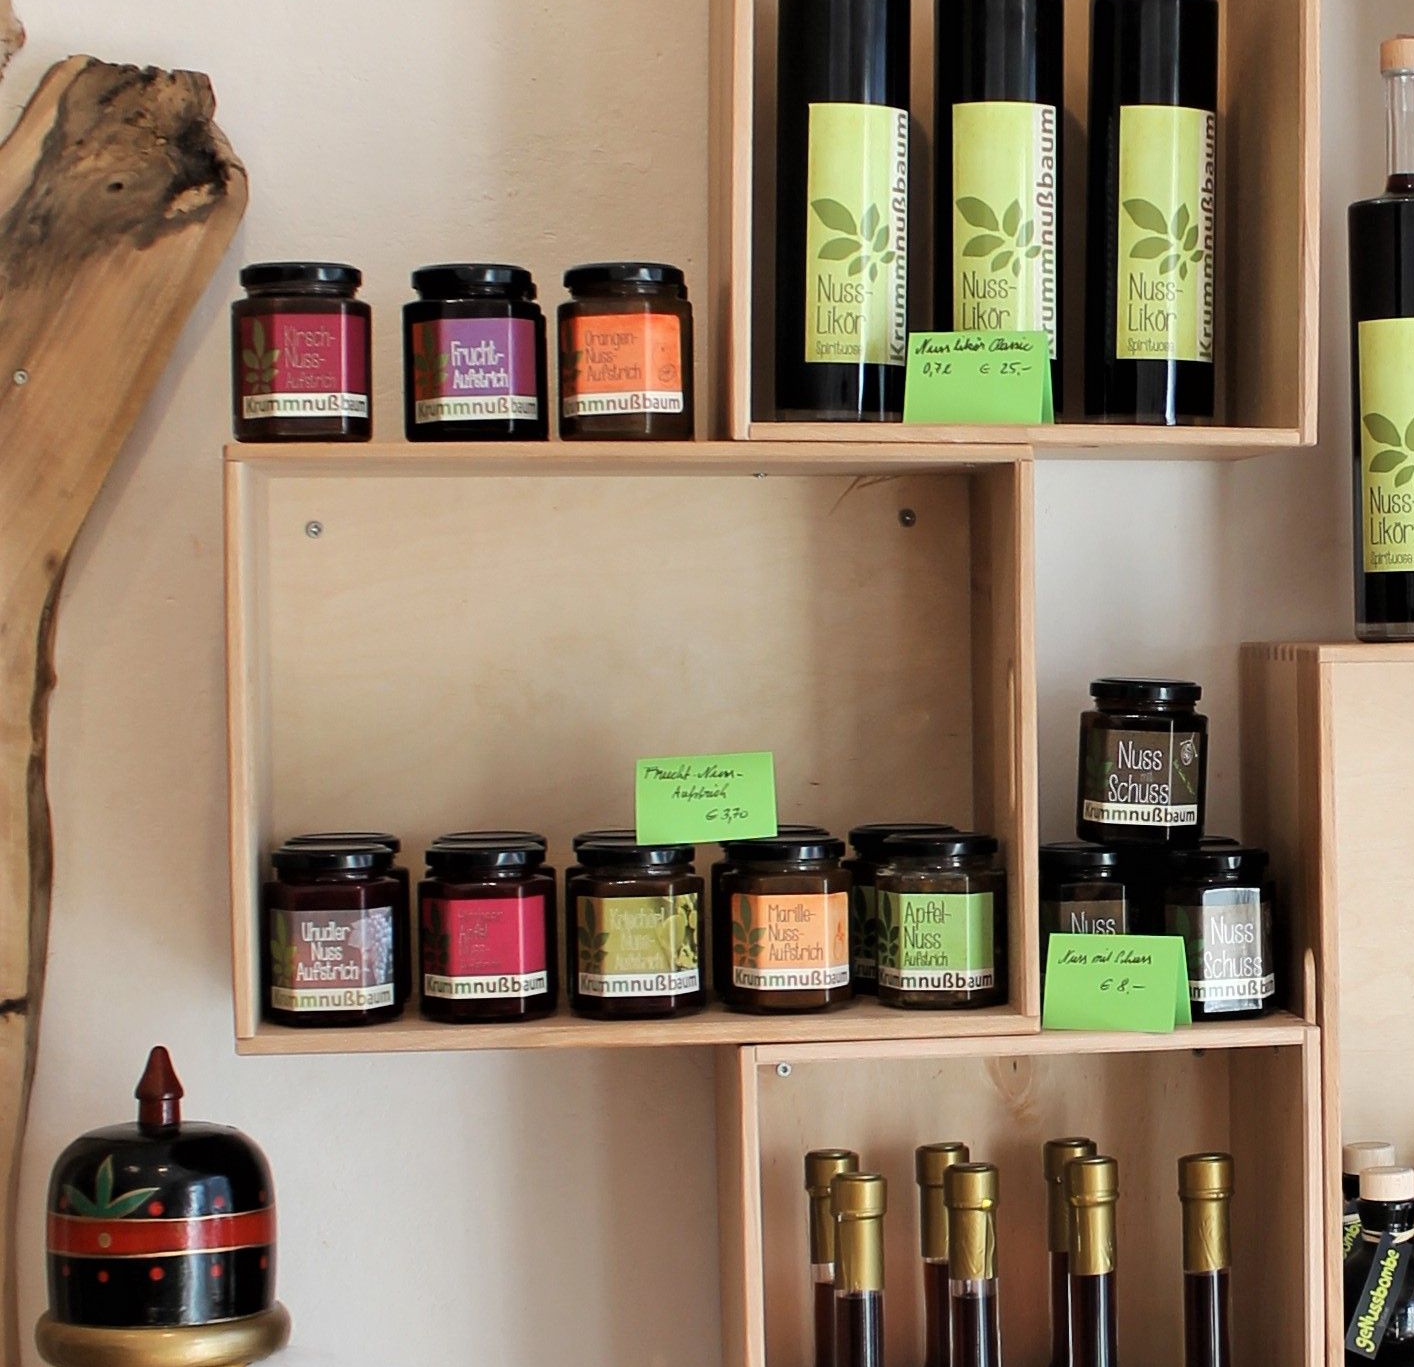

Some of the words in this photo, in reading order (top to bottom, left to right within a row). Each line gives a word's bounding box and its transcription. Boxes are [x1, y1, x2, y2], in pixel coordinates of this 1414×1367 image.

[889, 113, 907, 360] Krummnußbaum
[1200, 114, 1215, 360] Krummnußbaum
[817, 273, 873, 303] Nuss-
[962, 271, 1017, 300] Nuss-
[1129, 273, 1184, 301] Nuss-
[816, 305, 867, 335] Likör
[961, 302, 1011, 330] Likör
[1127, 303, 1177, 332] Likör
[451, 340, 504, 367] Frucht-
[453, 369, 509, 389] Aufstrich
[587, 364, 642, 382] Aufstrich
[1370, 517, 1414, 545] Likör
[1118, 741, 1163, 771] Nuss
[1108, 774, 1169, 804] Schuss
[705, 808, 718, 821] €
[720, 807, 749, 824] 3,70
[768, 904, 816, 924] Marille-
[904, 901, 951, 930] Apfel-
[1071, 912, 1116, 934] Nuss
[302, 921, 350, 943] Uhudler
[768, 926, 805, 943] Nuss-
[904, 926, 942, 950] Nuss
[1211, 916, 1254, 945] Nuss
[311, 942, 343, 963] Nuss
[769, 943, 824, 963] Aufstrich
[904, 951, 949, 967] Aufstrich
[1204, 951, 1262, 979] Schuss
[296, 961, 360, 983] Aufstrich
[735, 968, 848, 989] Krummnußbaum
[1100, 979, 1111, 991] €
[1355, 1248, 1400, 1353] geNussbombe
